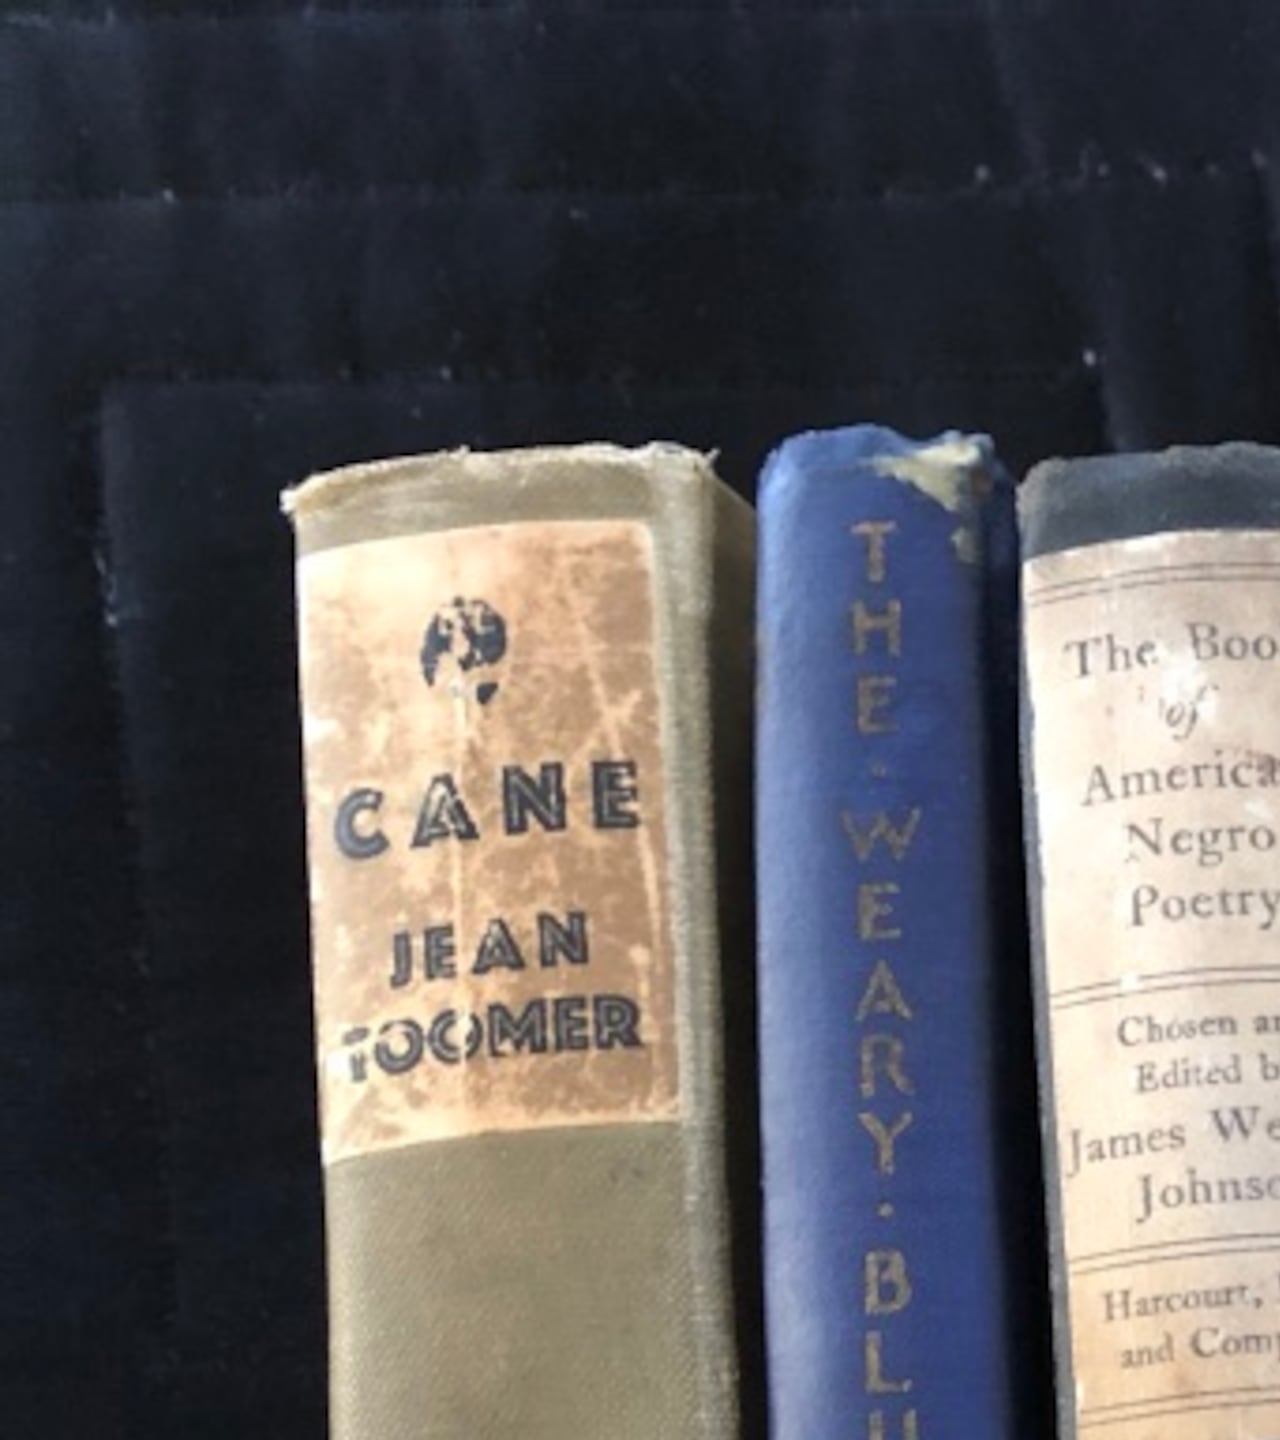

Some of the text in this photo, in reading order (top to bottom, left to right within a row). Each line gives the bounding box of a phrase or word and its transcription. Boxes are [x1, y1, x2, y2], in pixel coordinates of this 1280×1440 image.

[851, 521, 900, 733] THE
[1064, 634, 1158, 678] The
[1165, 684, 1218, 741] of
[334, 761, 640, 860] CANE
[1126, 818, 1276, 867] Negro
[391, 912, 588, 988] JEAN
[842, 808, 921, 1174] WEARY
[343, 994, 643, 1082] TOOMER
[1117, 1016, 1238, 1047] Chosen
[1136, 1055, 1241, 1093] Edited
[1067, 1123, 1187, 1175] James
[1103, 1281, 1263, 1321] Harcourt,
[1120, 1336, 1174, 1369] and
